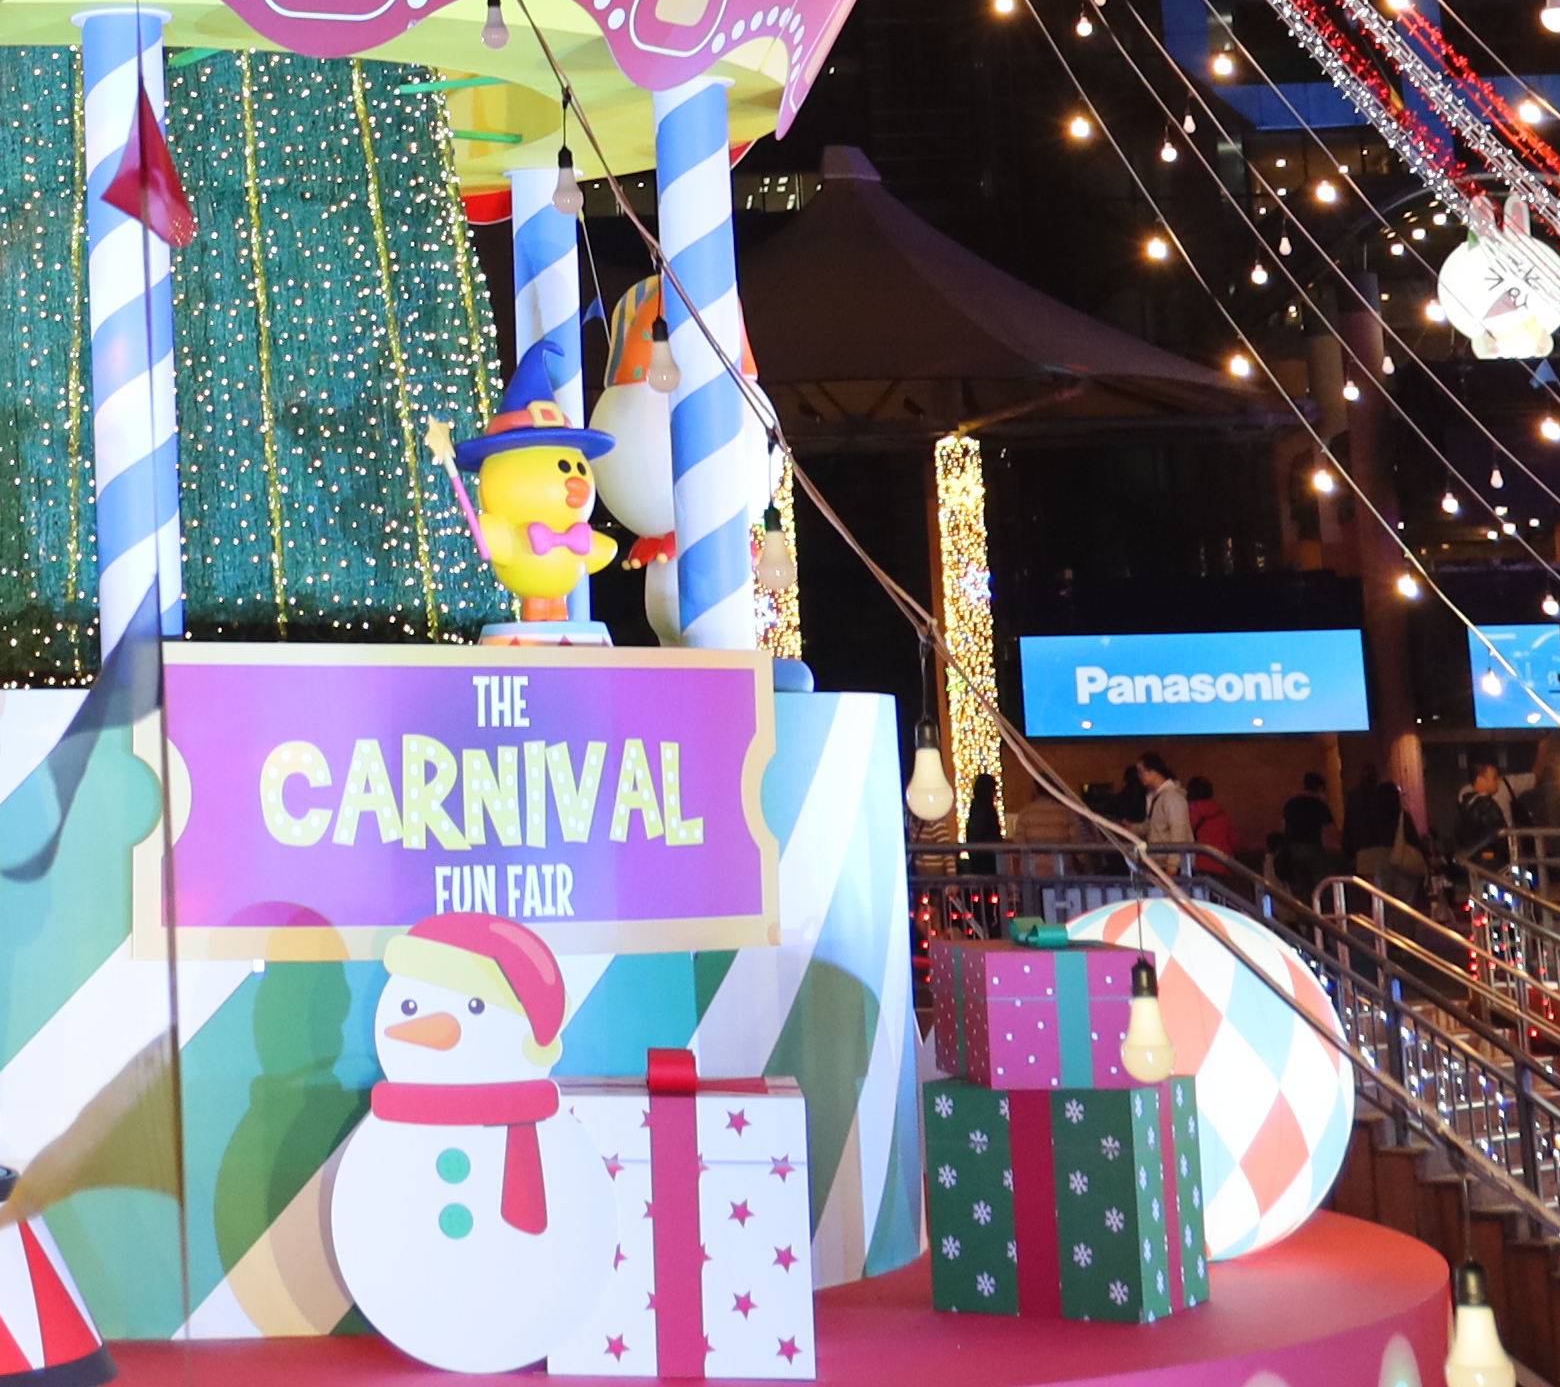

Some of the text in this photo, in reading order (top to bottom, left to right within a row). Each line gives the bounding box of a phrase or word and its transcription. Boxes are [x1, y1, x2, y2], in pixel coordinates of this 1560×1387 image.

[473, 676, 530, 727] THE
[1075, 663, 1311, 704] Panasonic
[259, 733, 704, 850] CARNIVAL
[435, 862, 575, 917] FUN FAIR
